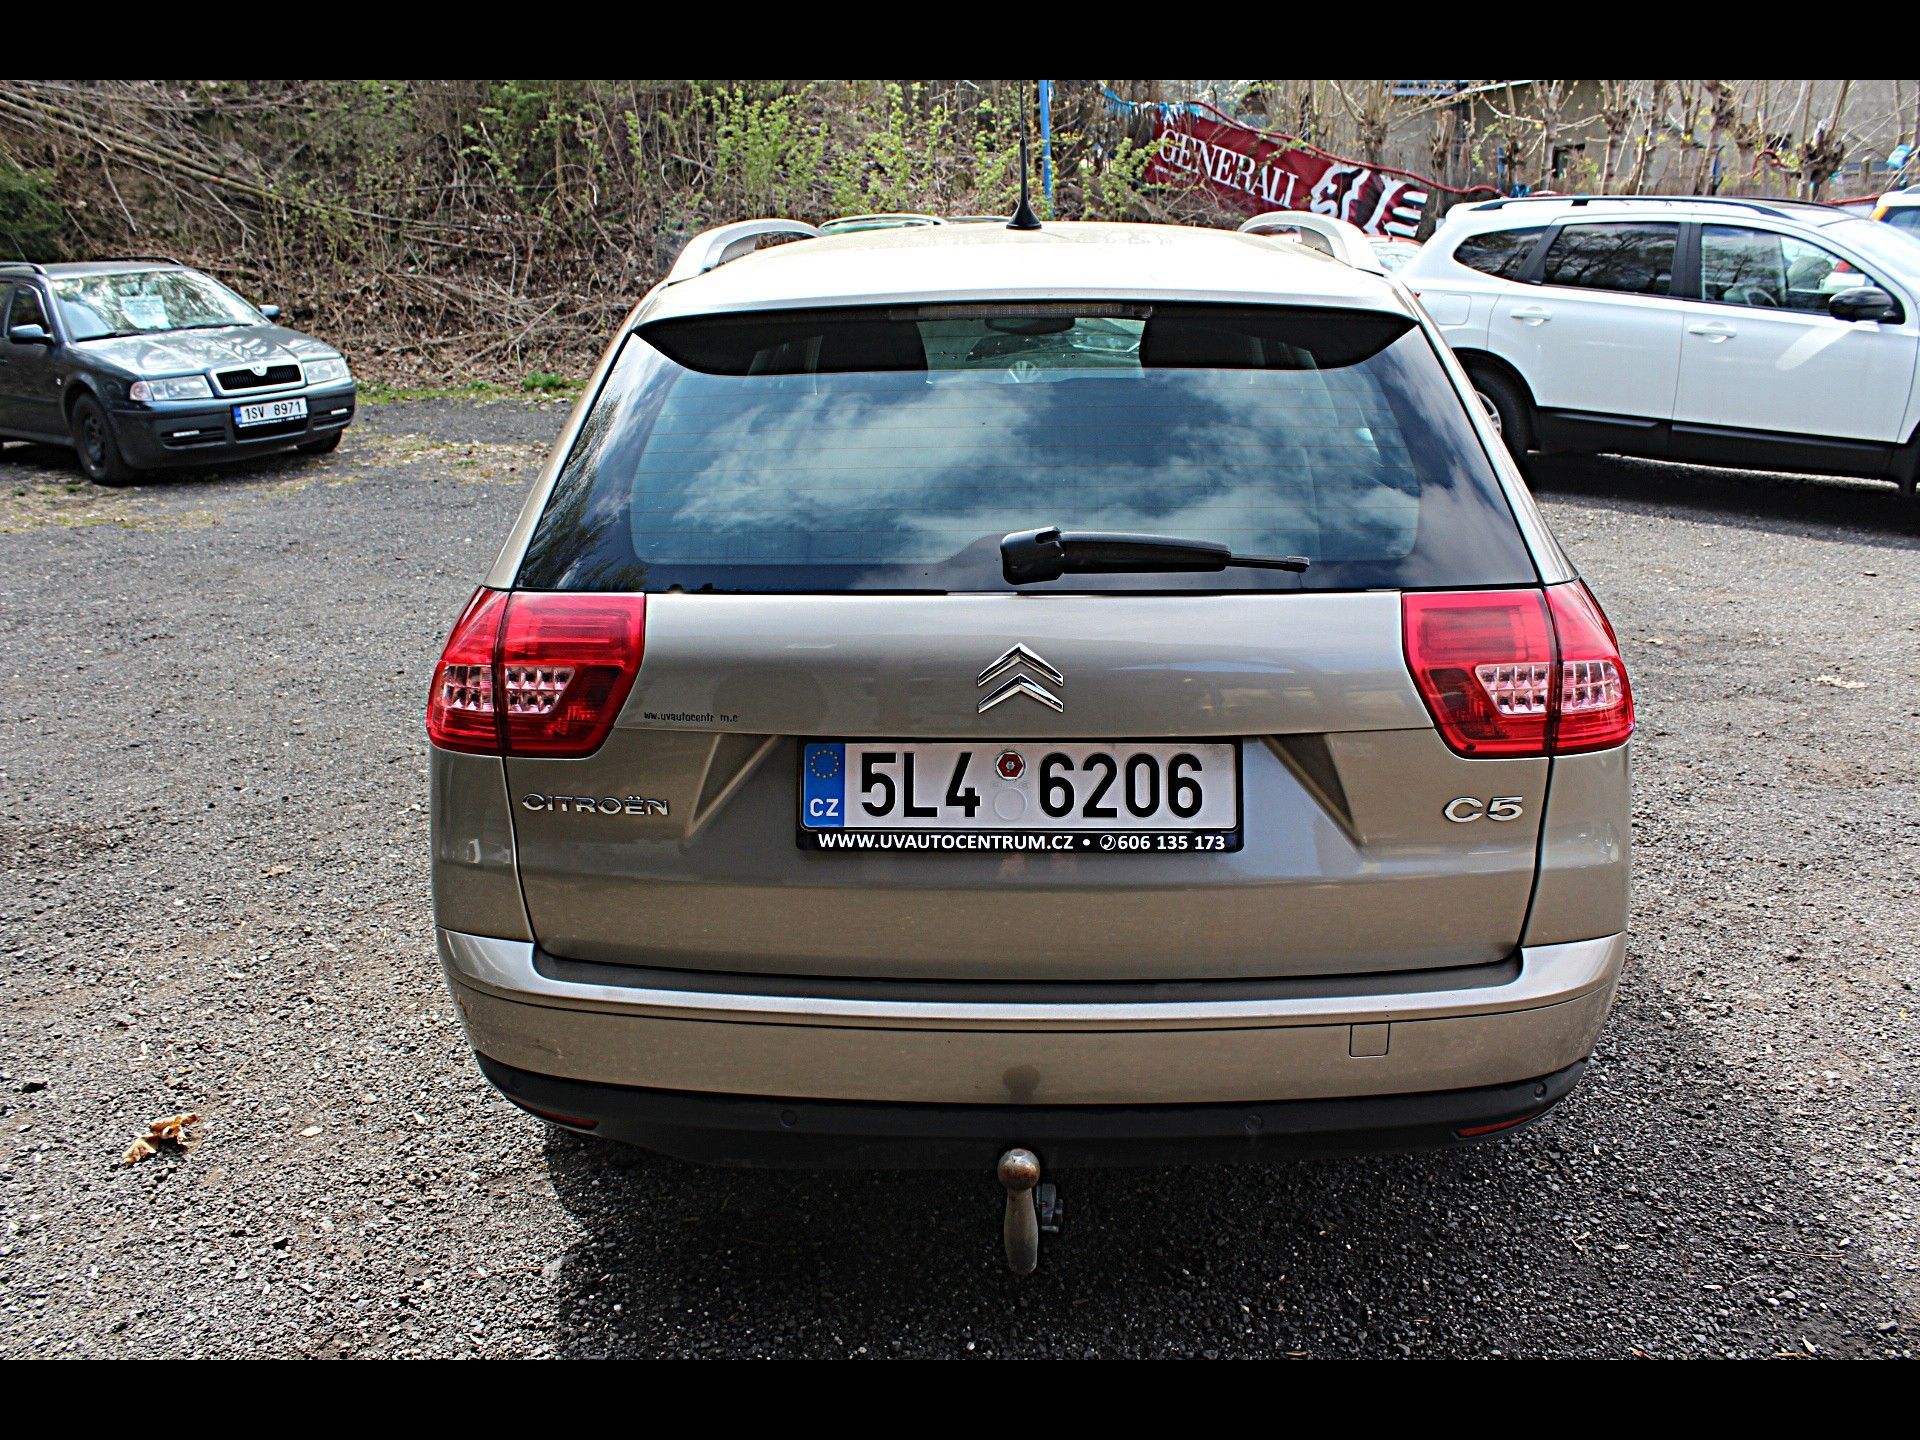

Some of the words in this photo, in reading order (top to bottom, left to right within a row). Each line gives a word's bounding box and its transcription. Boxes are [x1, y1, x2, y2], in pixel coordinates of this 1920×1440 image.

[1158, 128, 1299, 209] GENERALI
[244, 406, 264, 420] 1SV
[273, 401, 301, 416] 8971
[860, 752, 981, 818] 5L4
[1038, 752, 1203, 818] 6206
[522, 792, 669, 816] CITROËN
[808, 797, 839, 817] CZ
[1442, 795, 1524, 823] C5
[818, 833, 1074, 850] WWW.UVAUTOCENTRUM.CZ
[1117, 835, 1151, 850] 606
[1157, 835, 1188, 850] 135
[1194, 835, 1225, 850] 173
